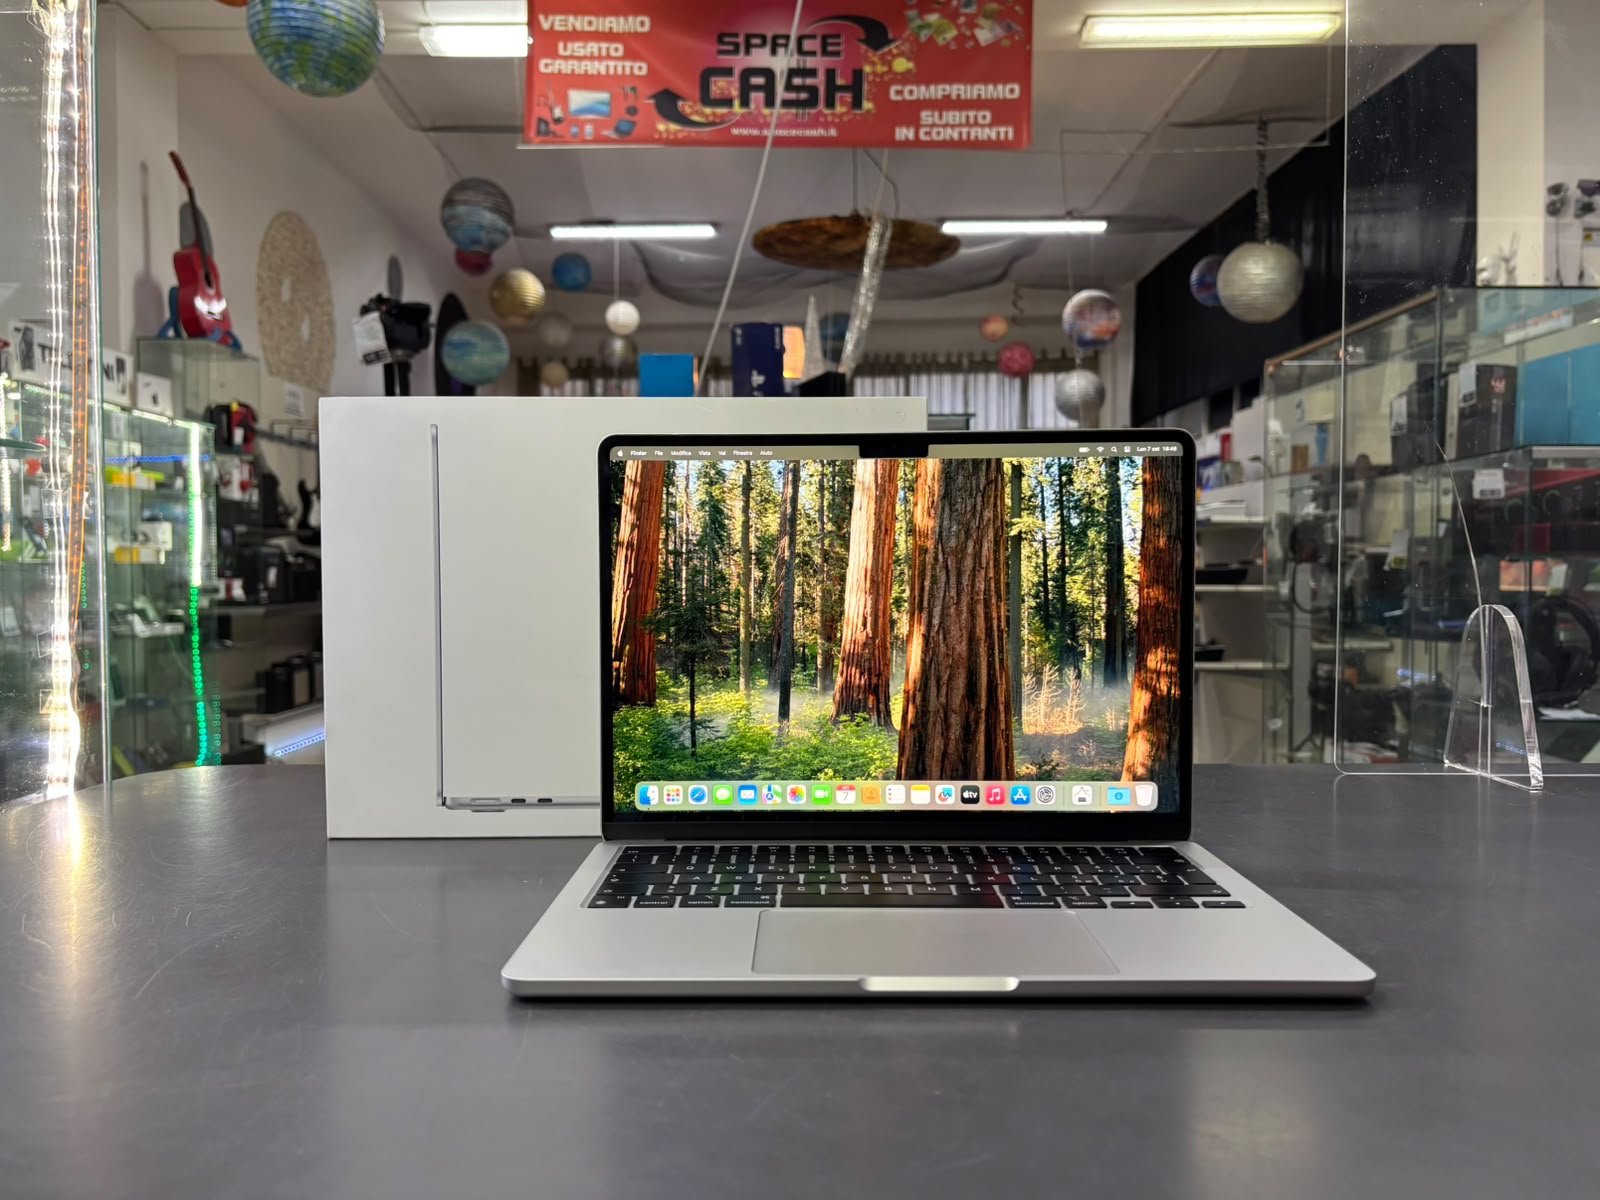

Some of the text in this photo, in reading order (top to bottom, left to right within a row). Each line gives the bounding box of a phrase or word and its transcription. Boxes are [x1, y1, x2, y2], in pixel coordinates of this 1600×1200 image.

[538, 14, 651, 33] VENDIAMO
[557, 41, 625, 57] USATO
[716, 32, 842, 57] SPACE
[538, 59, 648, 76] GARANTITO
[889, 83, 1020, 101] COMPRIAMO
[920, 110, 992, 126] SUBITO
[895, 126, 1014, 142] IN CONTANTI
